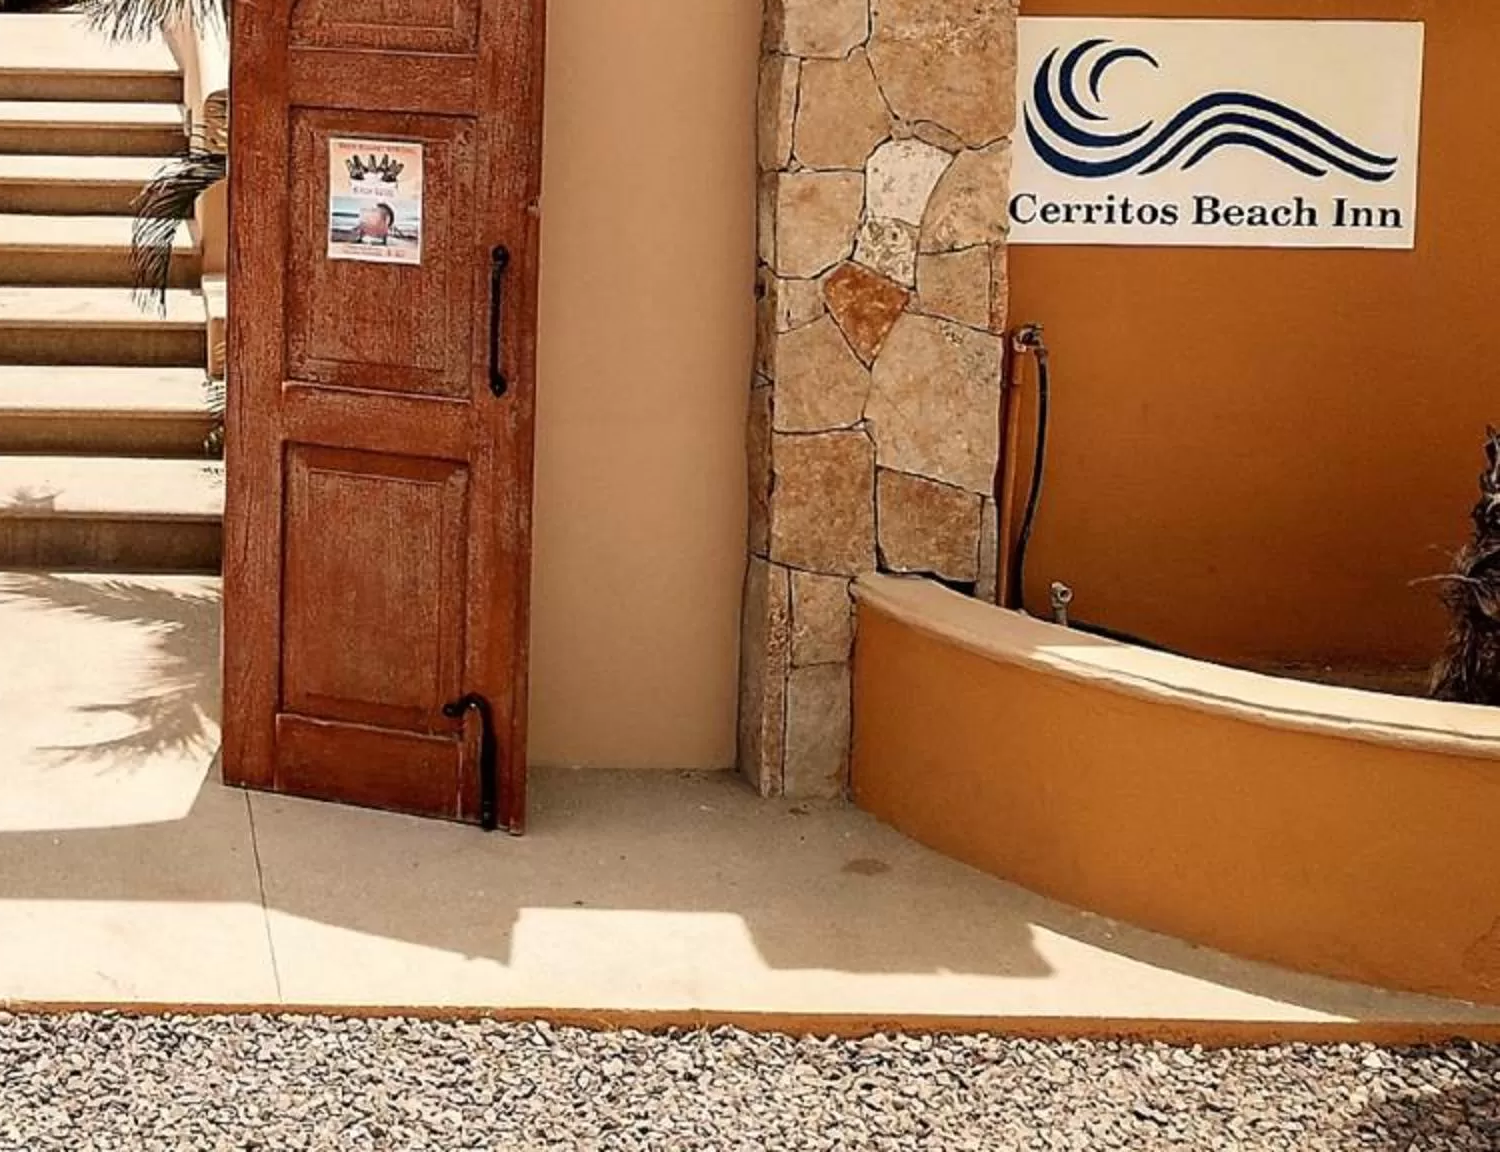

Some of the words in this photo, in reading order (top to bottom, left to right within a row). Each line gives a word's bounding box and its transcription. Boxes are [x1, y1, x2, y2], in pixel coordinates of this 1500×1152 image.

[1007, 193, 1178, 225] Cerritos
[1192, 195, 1318, 227] Beach
[1332, 198, 1403, 228] Inn
